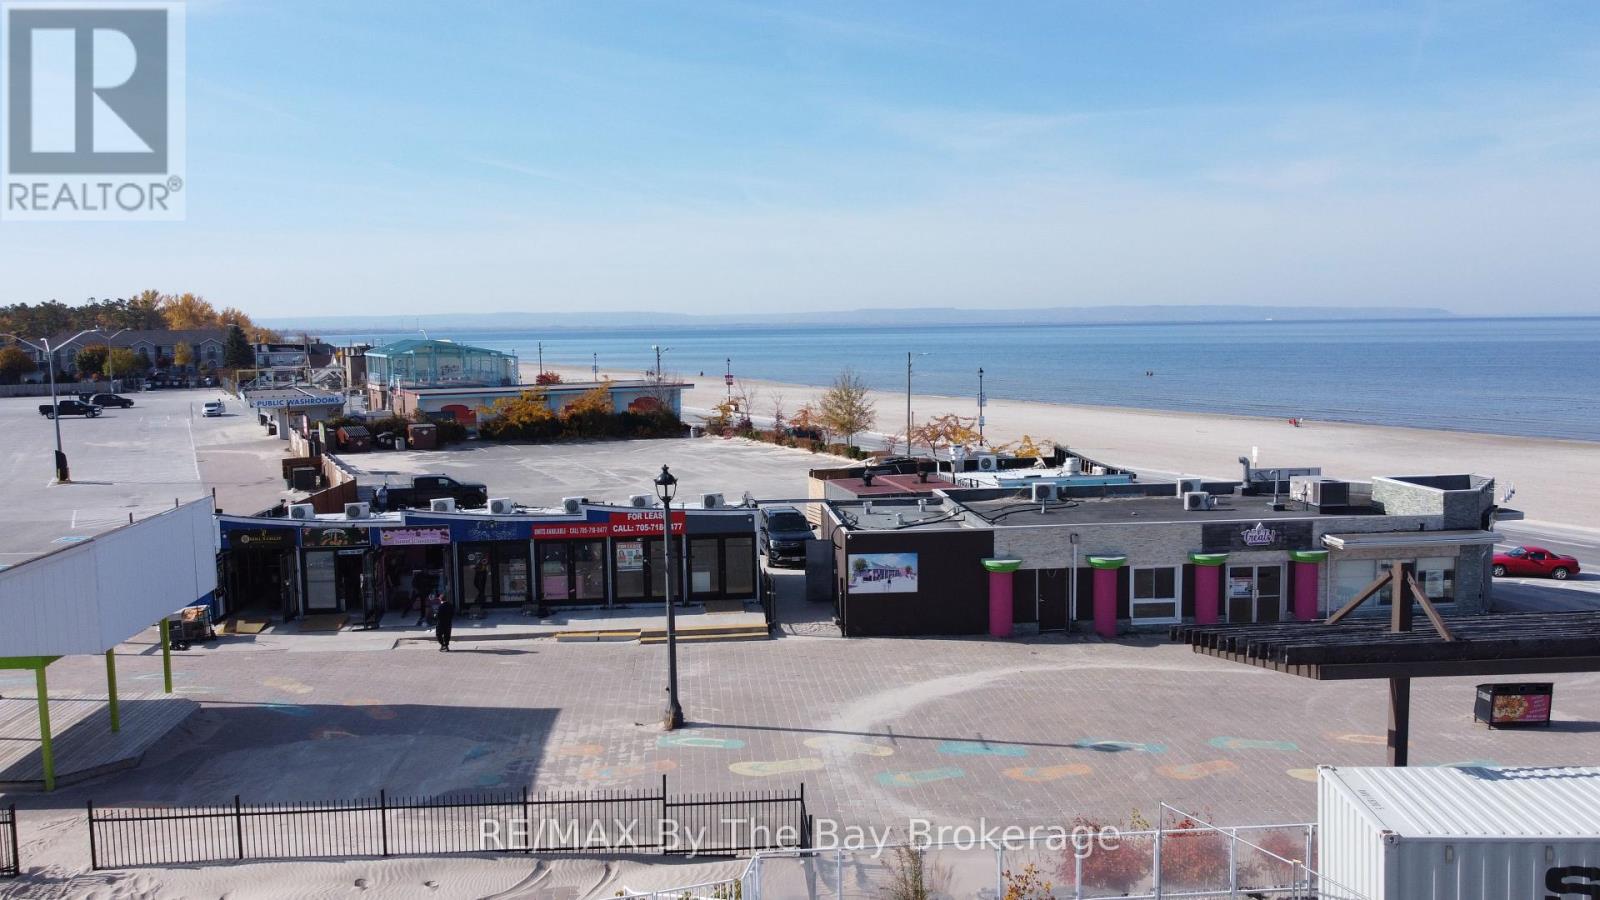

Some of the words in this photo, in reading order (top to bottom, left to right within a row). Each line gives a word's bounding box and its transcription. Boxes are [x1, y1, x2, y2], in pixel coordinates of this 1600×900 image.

[288, 397, 339, 405] WASHROOMS
[644, 512, 665, 520] LEAS
[613, 524, 634, 532] CALL:
